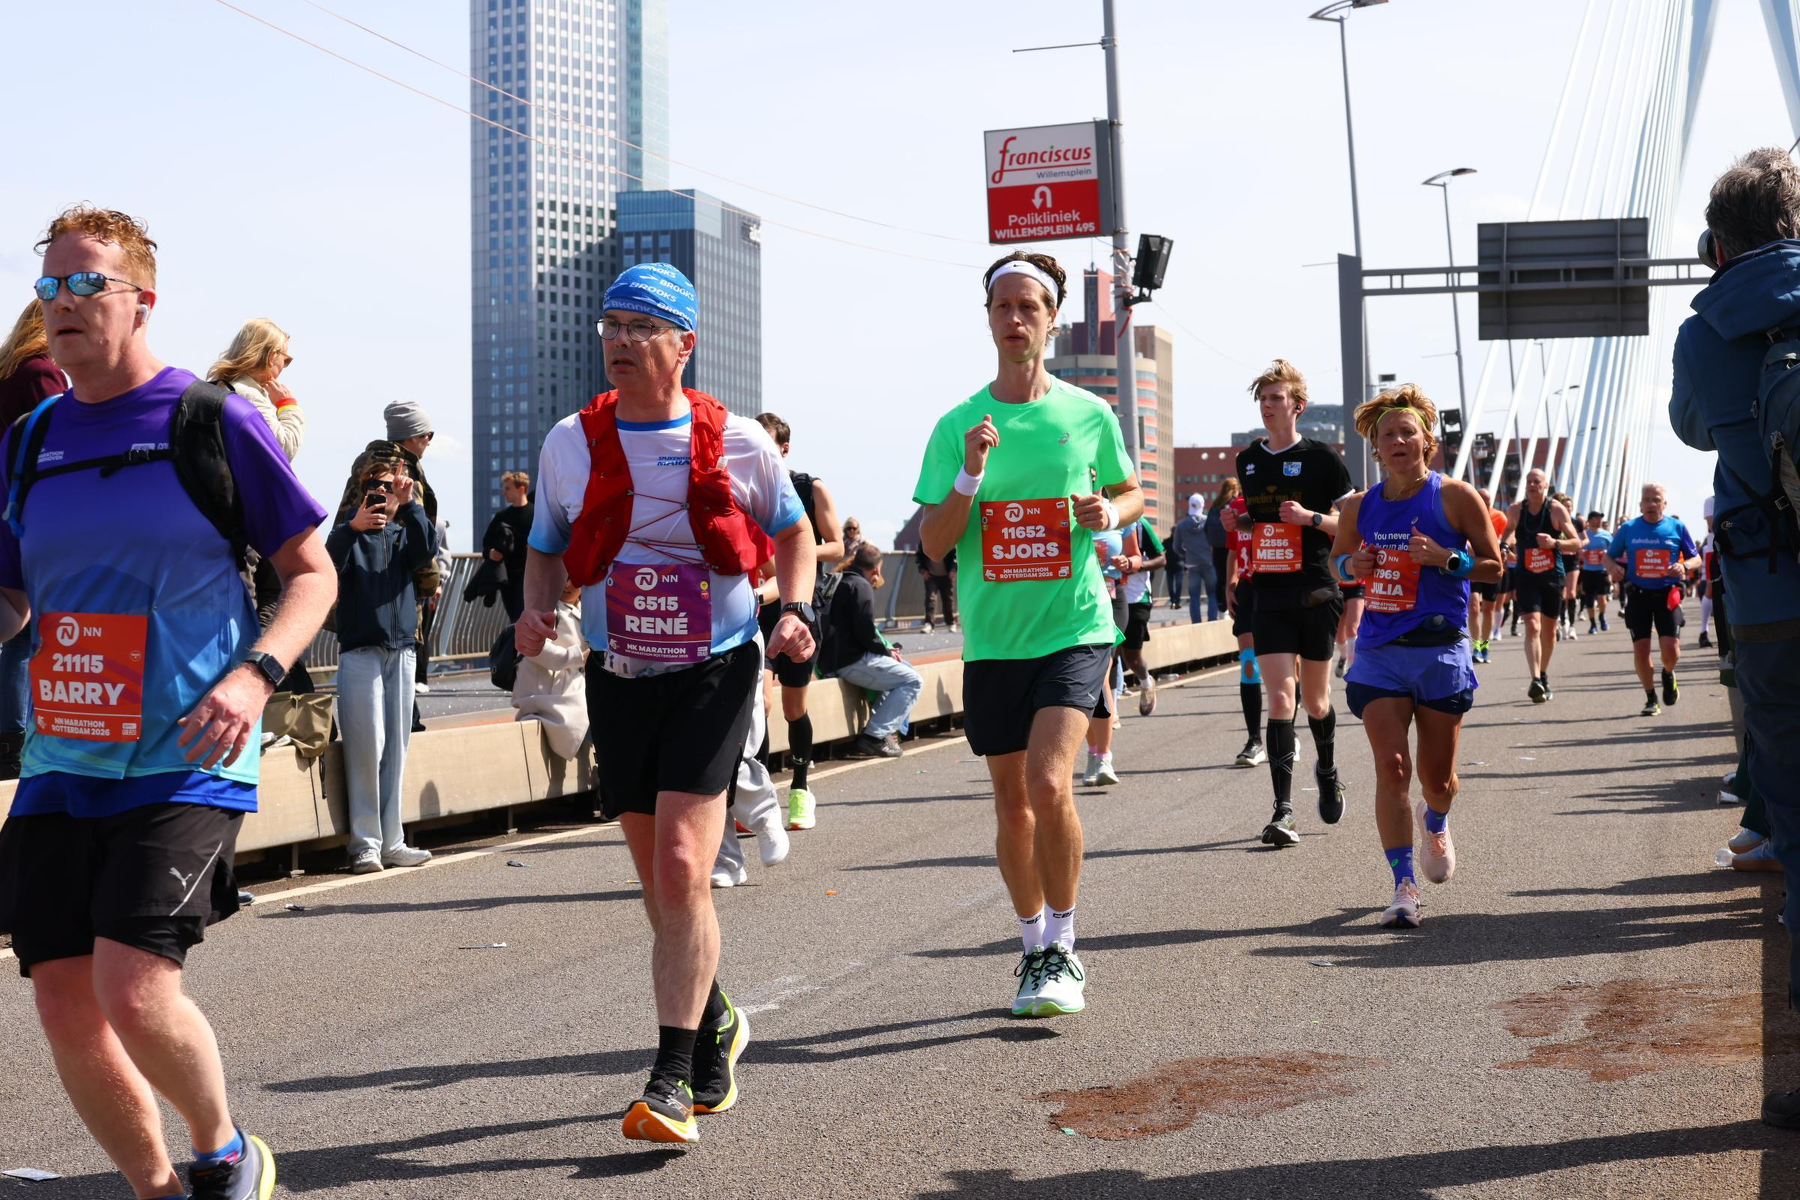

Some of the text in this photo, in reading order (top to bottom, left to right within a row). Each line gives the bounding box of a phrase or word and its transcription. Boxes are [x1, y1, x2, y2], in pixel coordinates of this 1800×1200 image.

[1036, 168, 1092, 179] Willemsplein
[1008, 209, 1081, 226] Polikliniek
[995, 222, 1096, 239] WILLEMSPLEIN 495
[629, 281, 677, 303] BROOKS
[660, 279, 695, 301] BROOKS
[1001, 525, 1046, 540] 11652
[1374, 532, 1410, 540] You never
[1260, 538, 1289, 547] 22556
[992, 542, 1060, 560] SJORS
[1256, 548, 1294, 560] MEES
[662, 574, 678, 582] NN
[1371, 582, 1404, 597] JULIA
[634, 596, 678, 611] 6515
[625, 612, 688, 635] RENÉ
[83, 627, 102, 637] NN
[639, 646, 686, 654] MARATHON
[52, 652, 104, 674] 21115
[38, 679, 126, 706] BARRY
[51, 724, 90, 734] ROTTERDAM
[54, 717, 64, 725] NN
[64, 718, 105, 728] MARATHON
